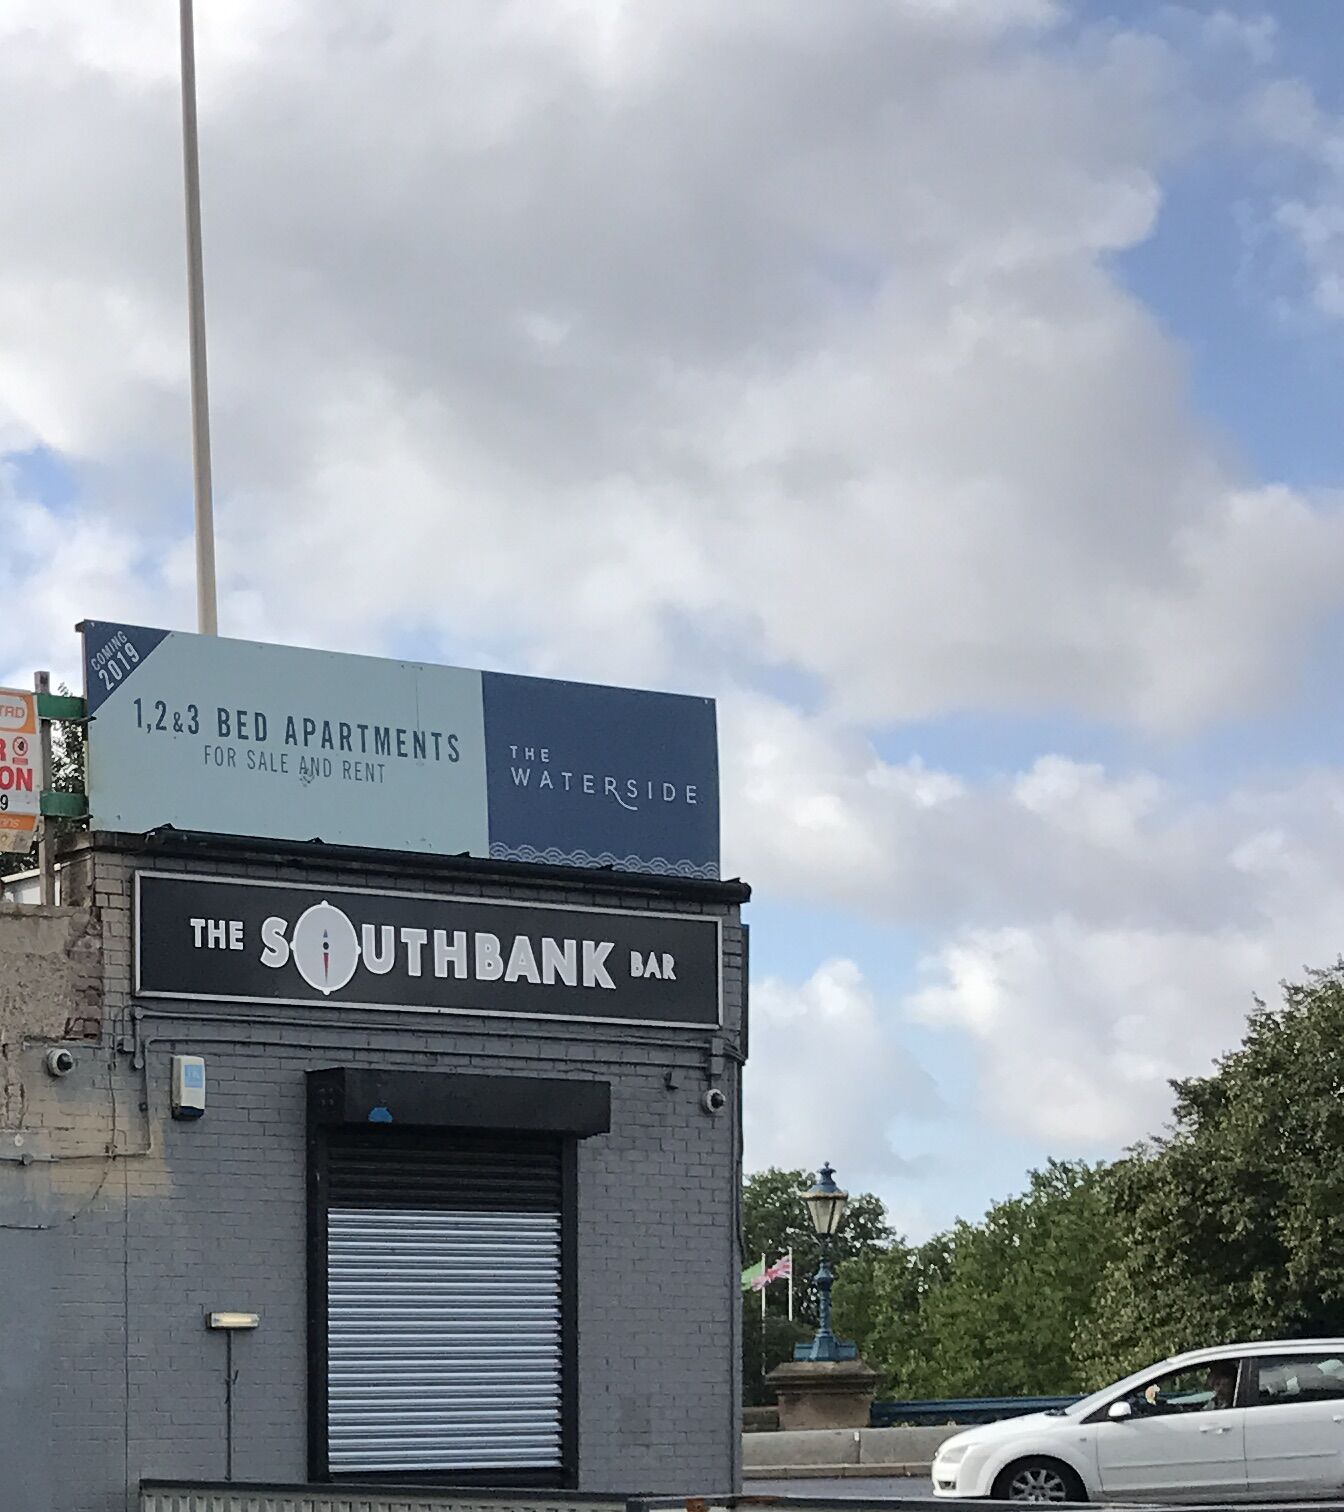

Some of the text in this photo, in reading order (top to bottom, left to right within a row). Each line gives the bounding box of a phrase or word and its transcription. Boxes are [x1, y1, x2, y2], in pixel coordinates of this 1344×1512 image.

[90, 631, 128, 671] COMING
[98, 642, 140, 690] 2019
[217, 707, 267, 742] BED
[284, 715, 460, 763] APARTMENTS
[509, 745, 550, 762] THE
[204, 744, 385, 783] FOR SALE AND RENT
[510, 766, 697, 810] WATERSIDE
[190, 900, 677, 996] THE SOUTHBANK BAR
